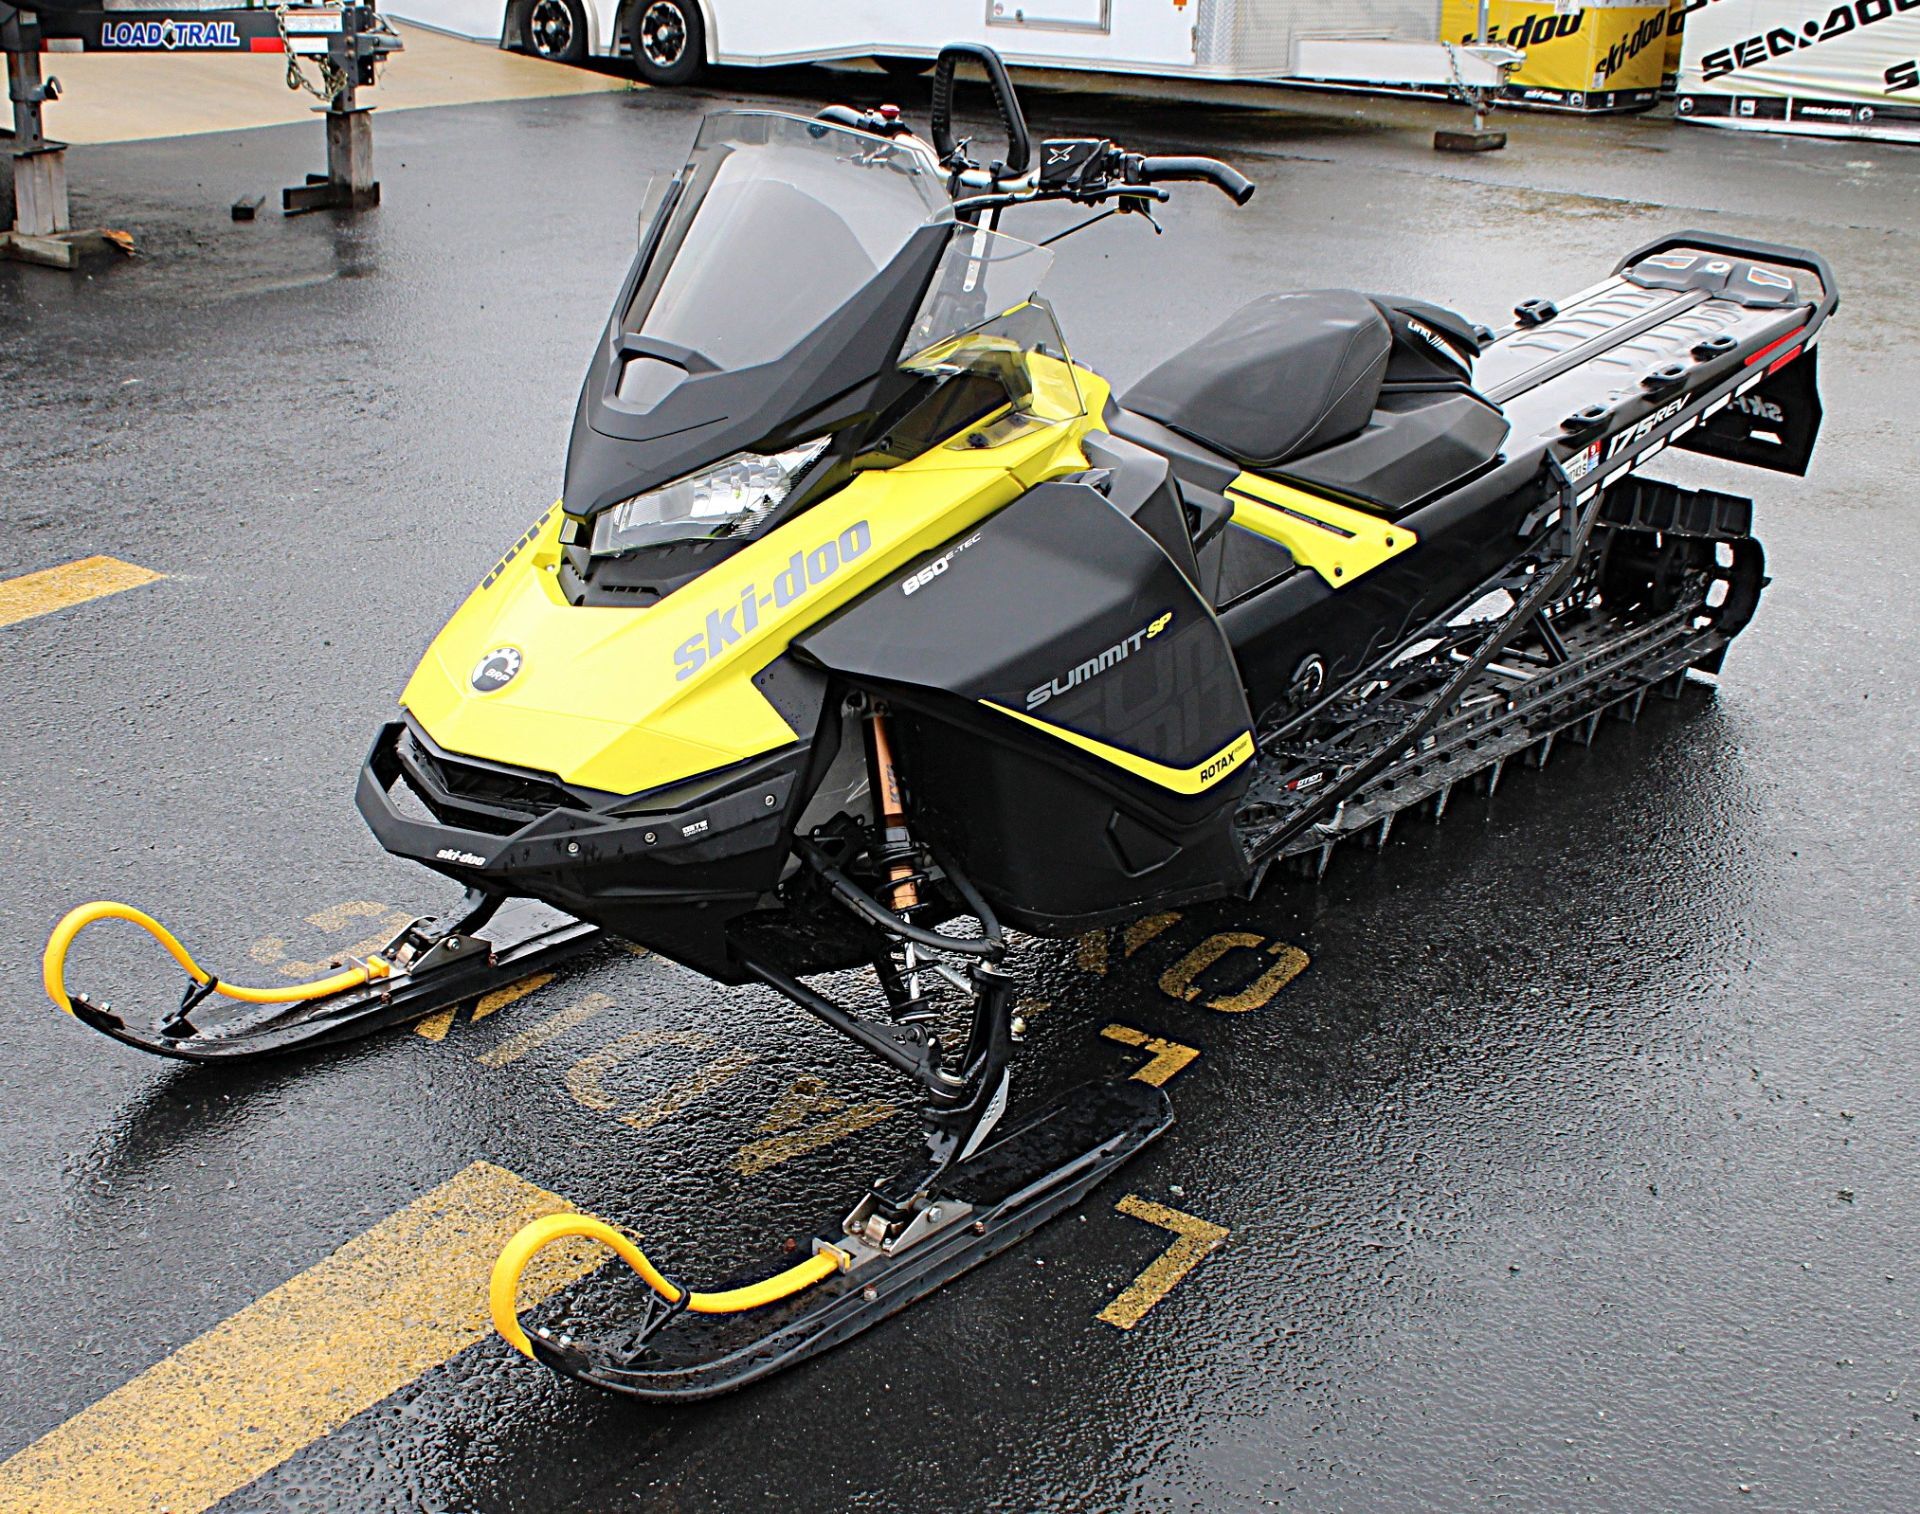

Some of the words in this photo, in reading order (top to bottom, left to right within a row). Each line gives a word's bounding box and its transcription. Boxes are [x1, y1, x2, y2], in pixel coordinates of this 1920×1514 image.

[102, 22, 163, 46] LOAD
[174, 22, 241, 46] TRAIL
[1606, 412, 1658, 461] 175
[1653, 392, 1691, 425] REV
[902, 556, 949, 597] 850
[945, 531, 981, 561] E-TEC
[673, 519, 872, 682] ski-doo
[484, 667, 511, 682] BRP
[1026, 628, 1148, 711] SUMMIT
[1146, 611, 1173, 639] SP
[1200, 750, 1236, 784] ROTAX
[436, 848, 487, 866] ski-doo
